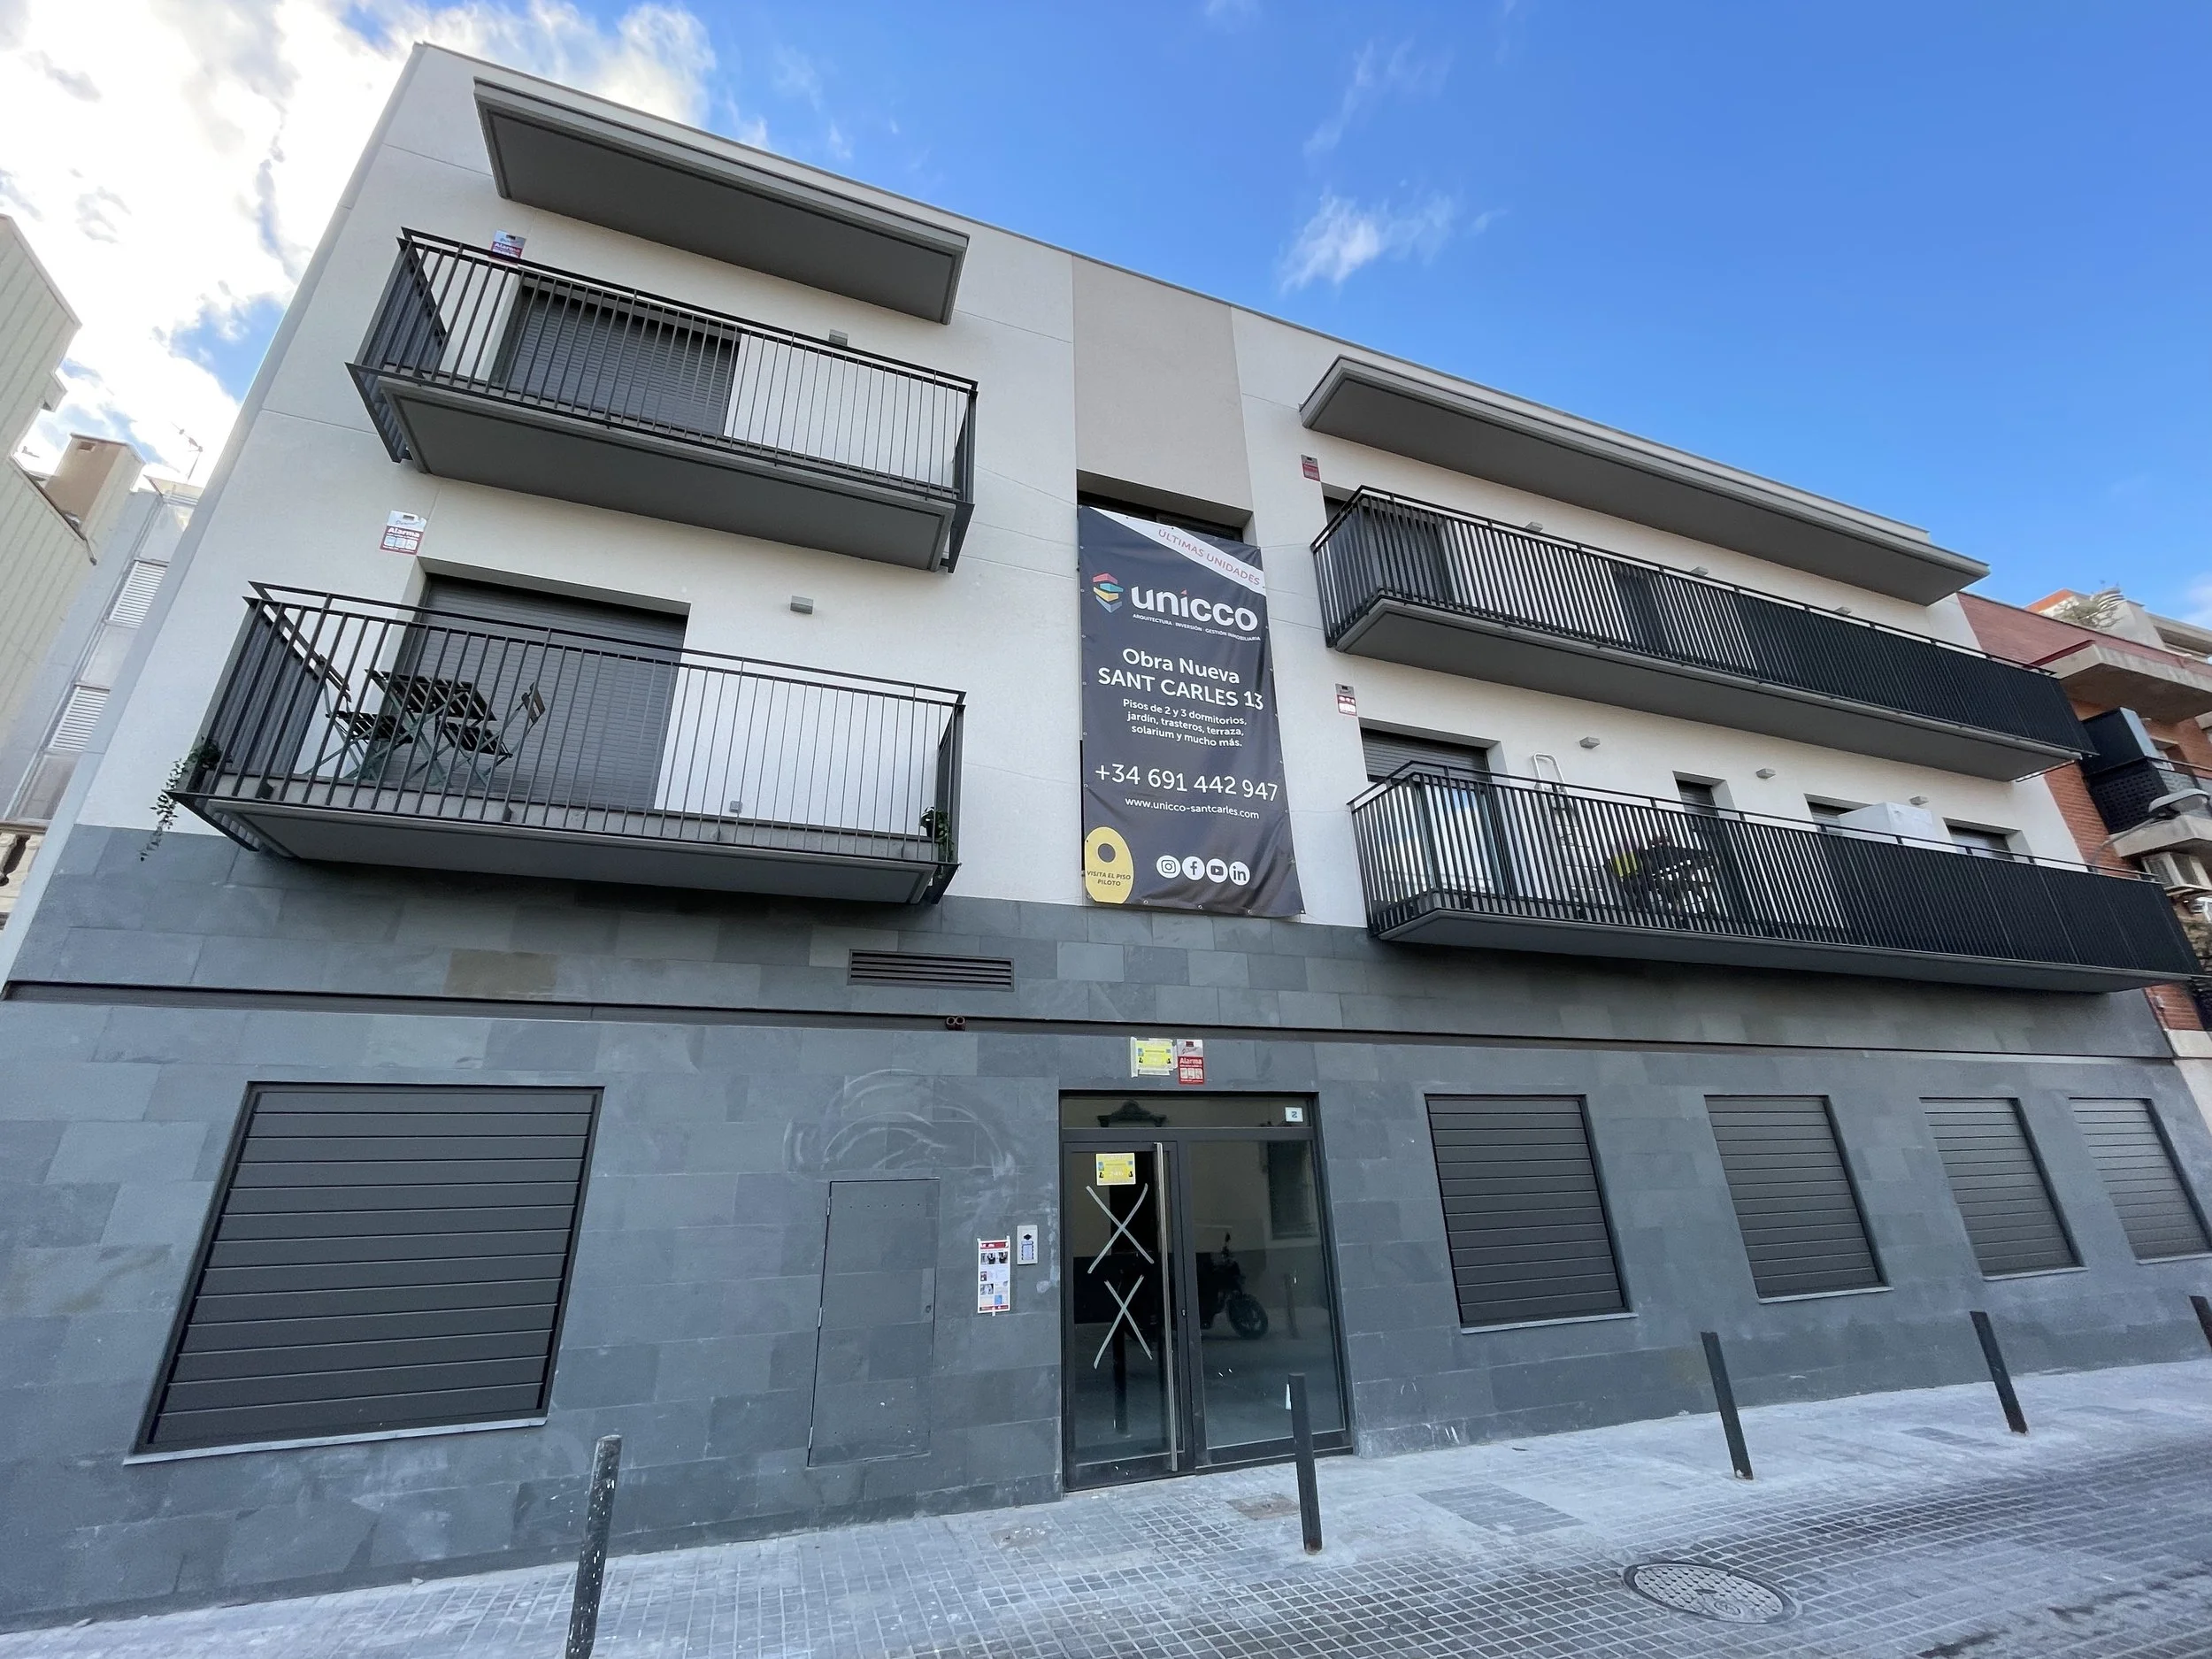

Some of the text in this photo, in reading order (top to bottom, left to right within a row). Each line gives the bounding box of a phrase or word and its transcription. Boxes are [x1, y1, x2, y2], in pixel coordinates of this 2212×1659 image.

[388, 526, 420, 538] Alarma
[1206, 553, 1261, 586] UNIDADES
[1131, 586, 1258, 631] unicco
[1133, 613, 1173, 626] ARQUITECTURA
[1123, 648, 1240, 684] Obra Nueva
[1098, 667, 1263, 710] SANT CARLES 13
[1123, 698, 1248, 726] Pisos de 2 y 3 dormitorios,
[1126, 711, 1244, 736] jardín, trasteros, terraza,
[1131, 726, 1242, 747] solarium y mucho más.
[1095, 763, 1278, 802] +34 691 442 947
[1125, 797, 1259, 819] www.unicco-santcarles.com
